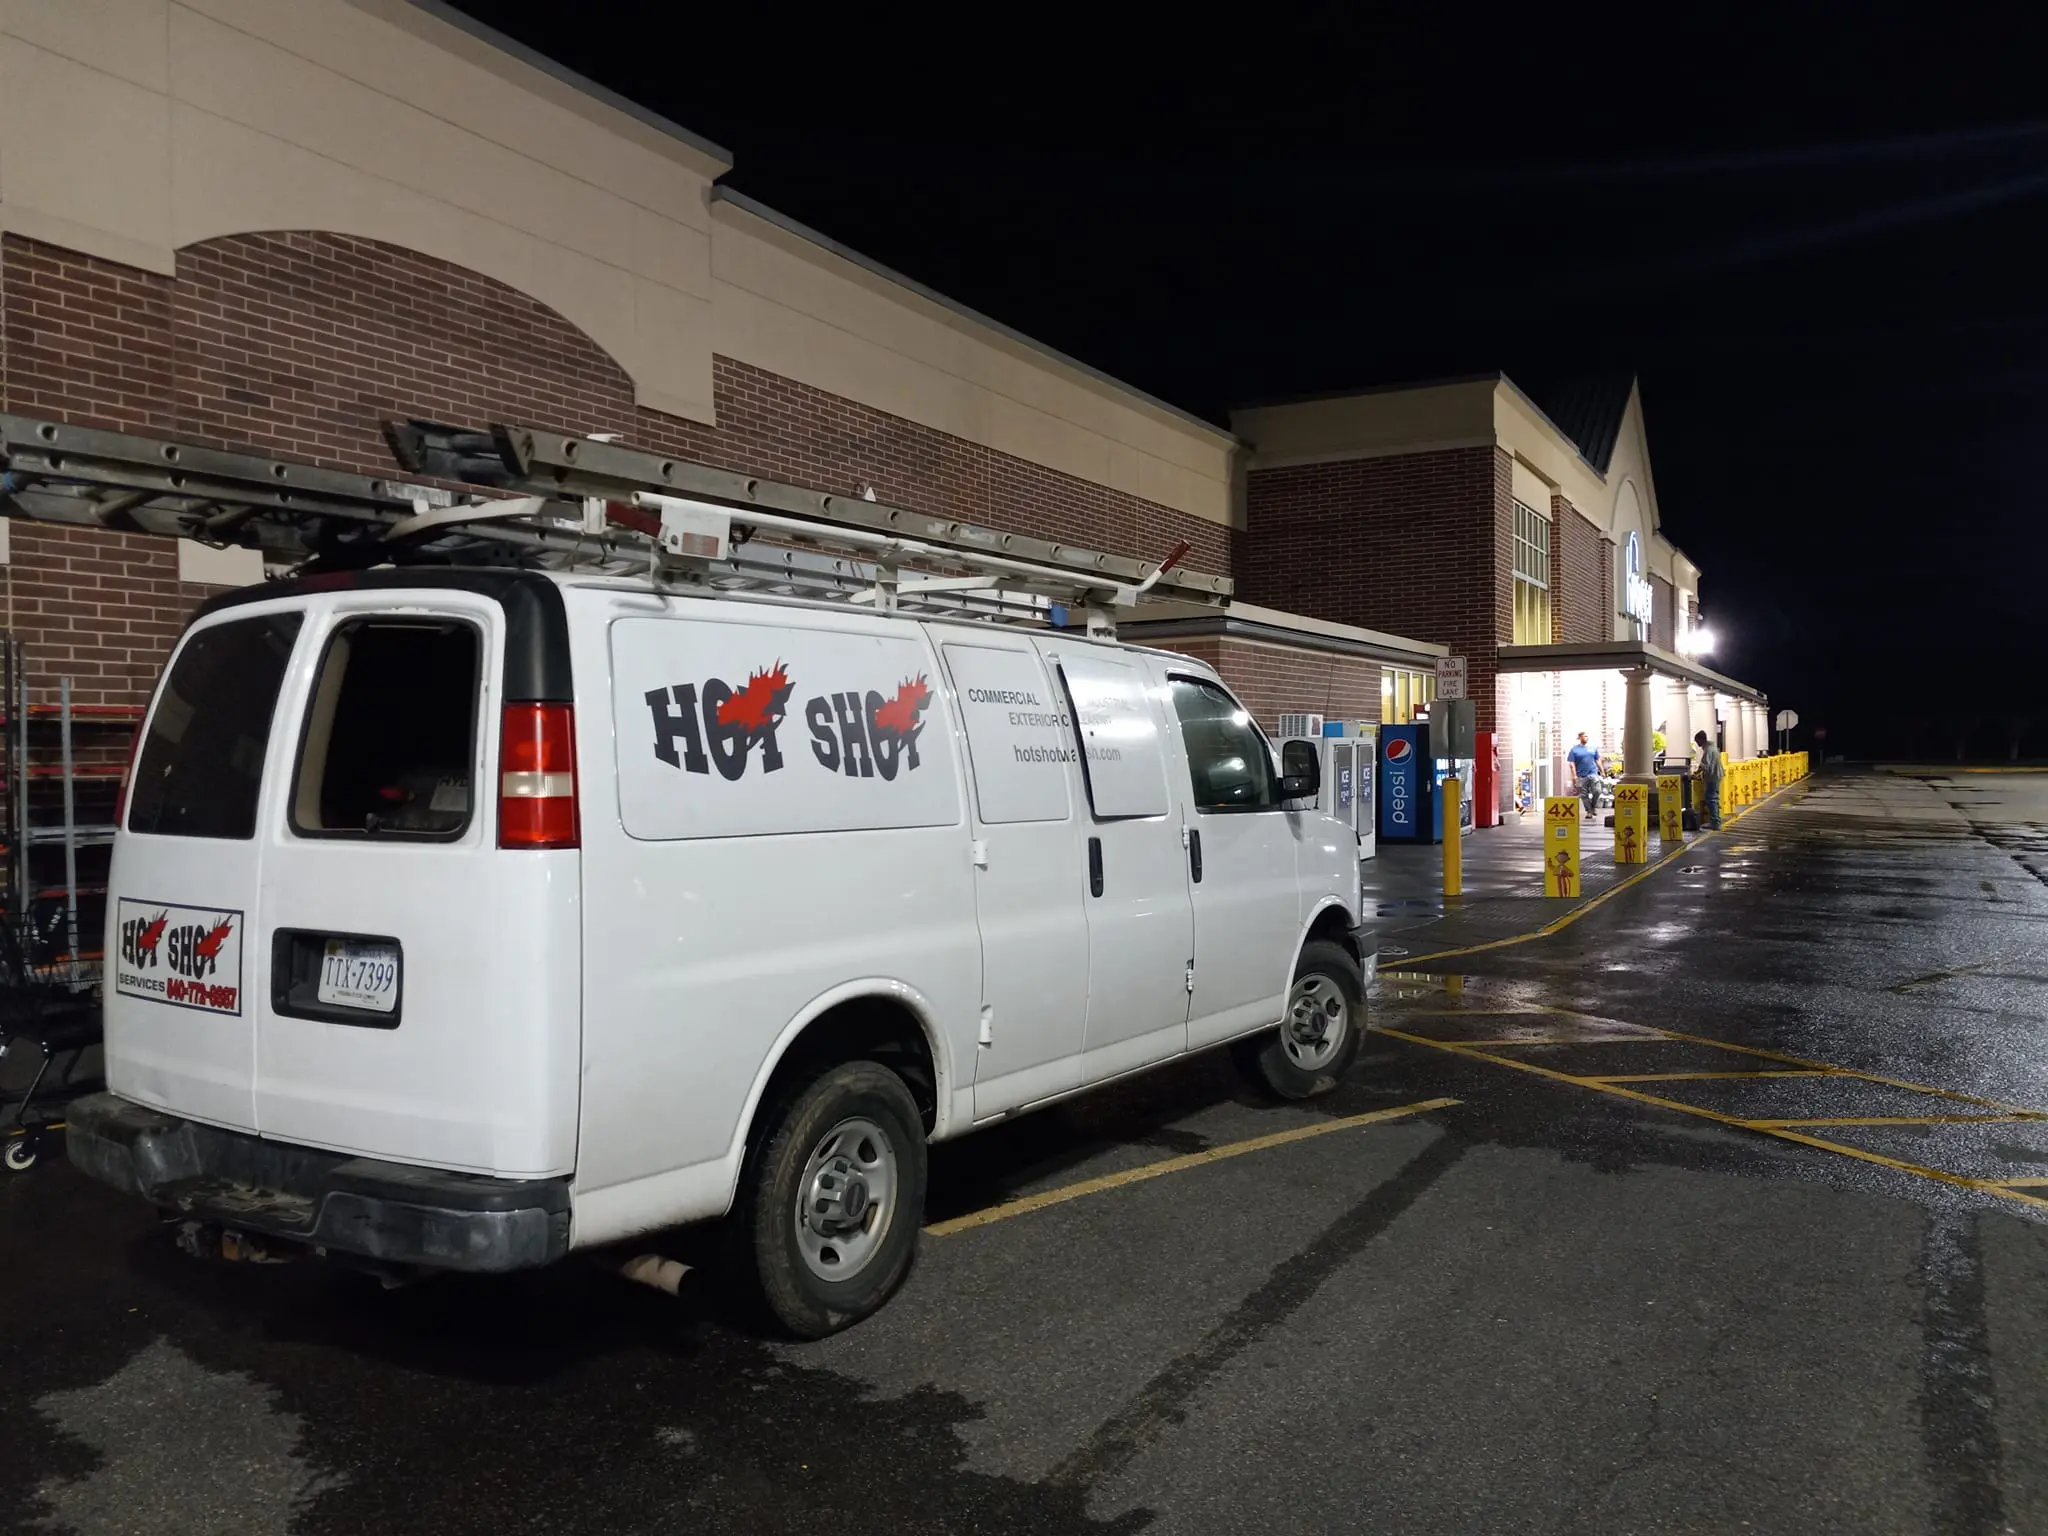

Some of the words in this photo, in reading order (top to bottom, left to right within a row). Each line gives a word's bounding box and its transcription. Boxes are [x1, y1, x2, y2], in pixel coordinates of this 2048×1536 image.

[1444, 661, 1456, 669] NO
[1438, 669, 1462, 678] PARKING
[1443, 680, 1457, 688] FIRE
[968, 688, 1040, 706] COMMERCIAL
[645, 657, 796, 781] HOT
[805, 669, 934, 781] SHOT
[1008, 712, 1059, 727] EXTERIOR
[1661, 779, 1679, 789] 4X
[1389, 771, 1409, 824] pepsi
[1617, 789, 1639, 801] 4X
[1547, 803, 1575, 818] 4X
[121, 908, 169, 970] HOT
[119, 972, 166, 993] SERVICES
